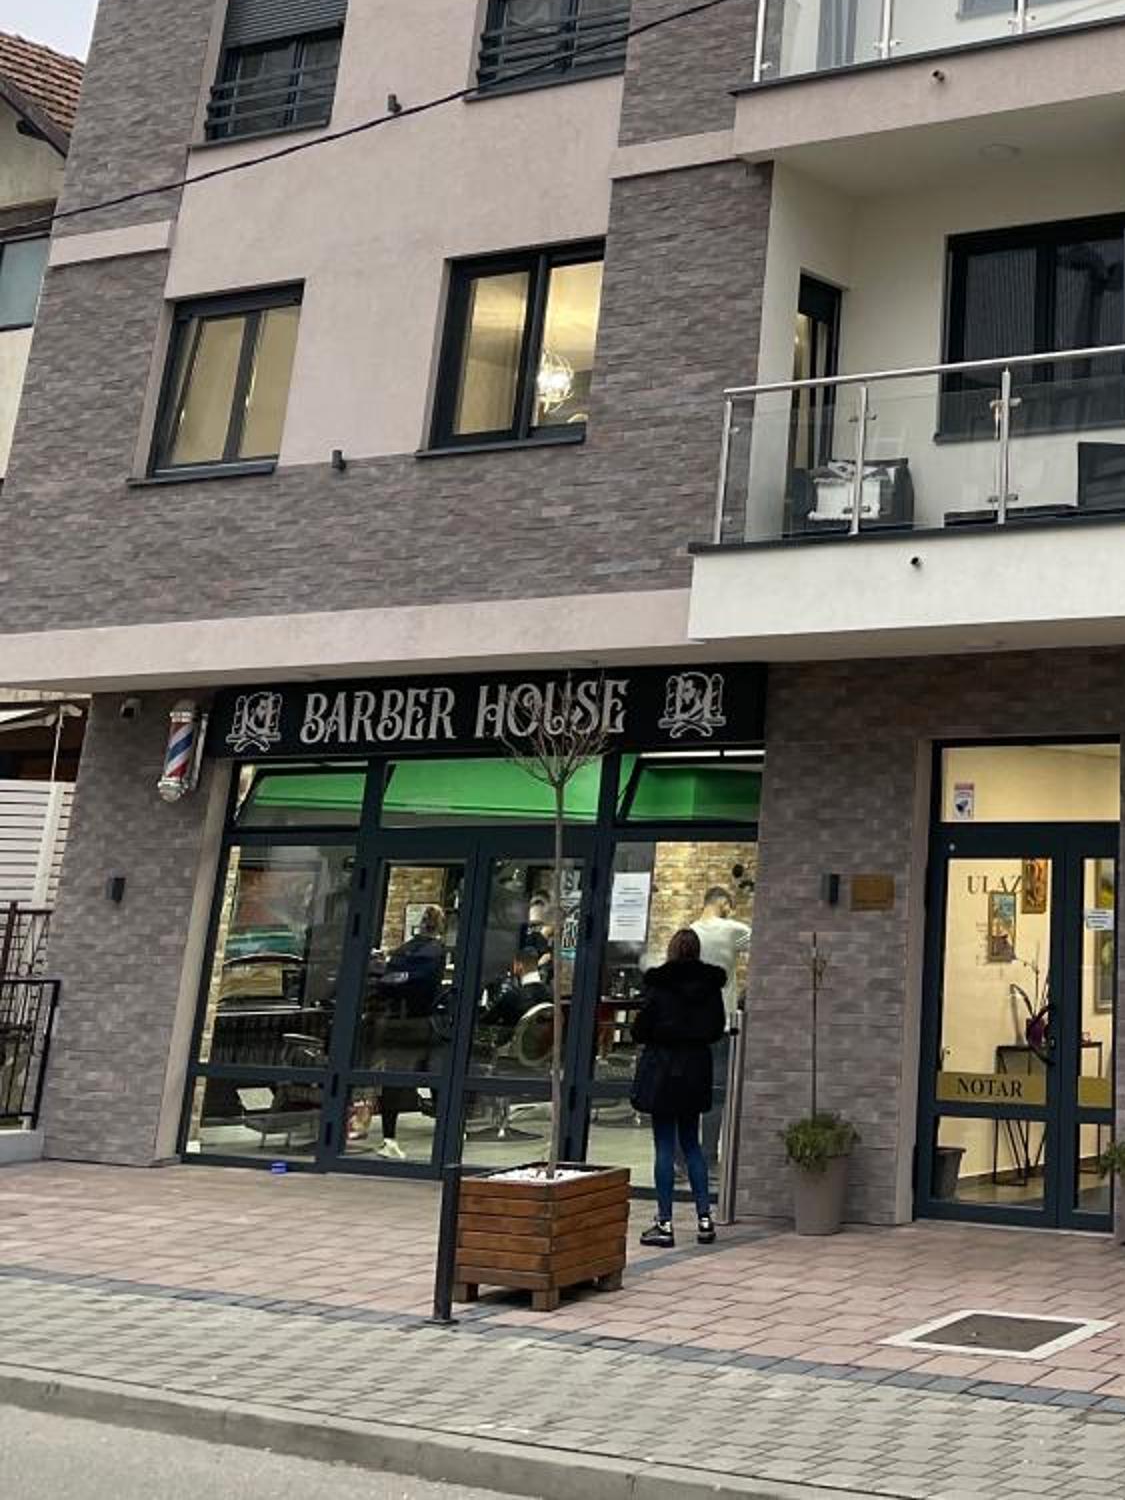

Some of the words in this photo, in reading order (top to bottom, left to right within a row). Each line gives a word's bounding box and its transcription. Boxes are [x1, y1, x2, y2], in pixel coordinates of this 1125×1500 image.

[300, 687, 457, 744] BARBER
[474, 679, 630, 739] HOUSE
[957, 1077, 1023, 1098] NOTAR
